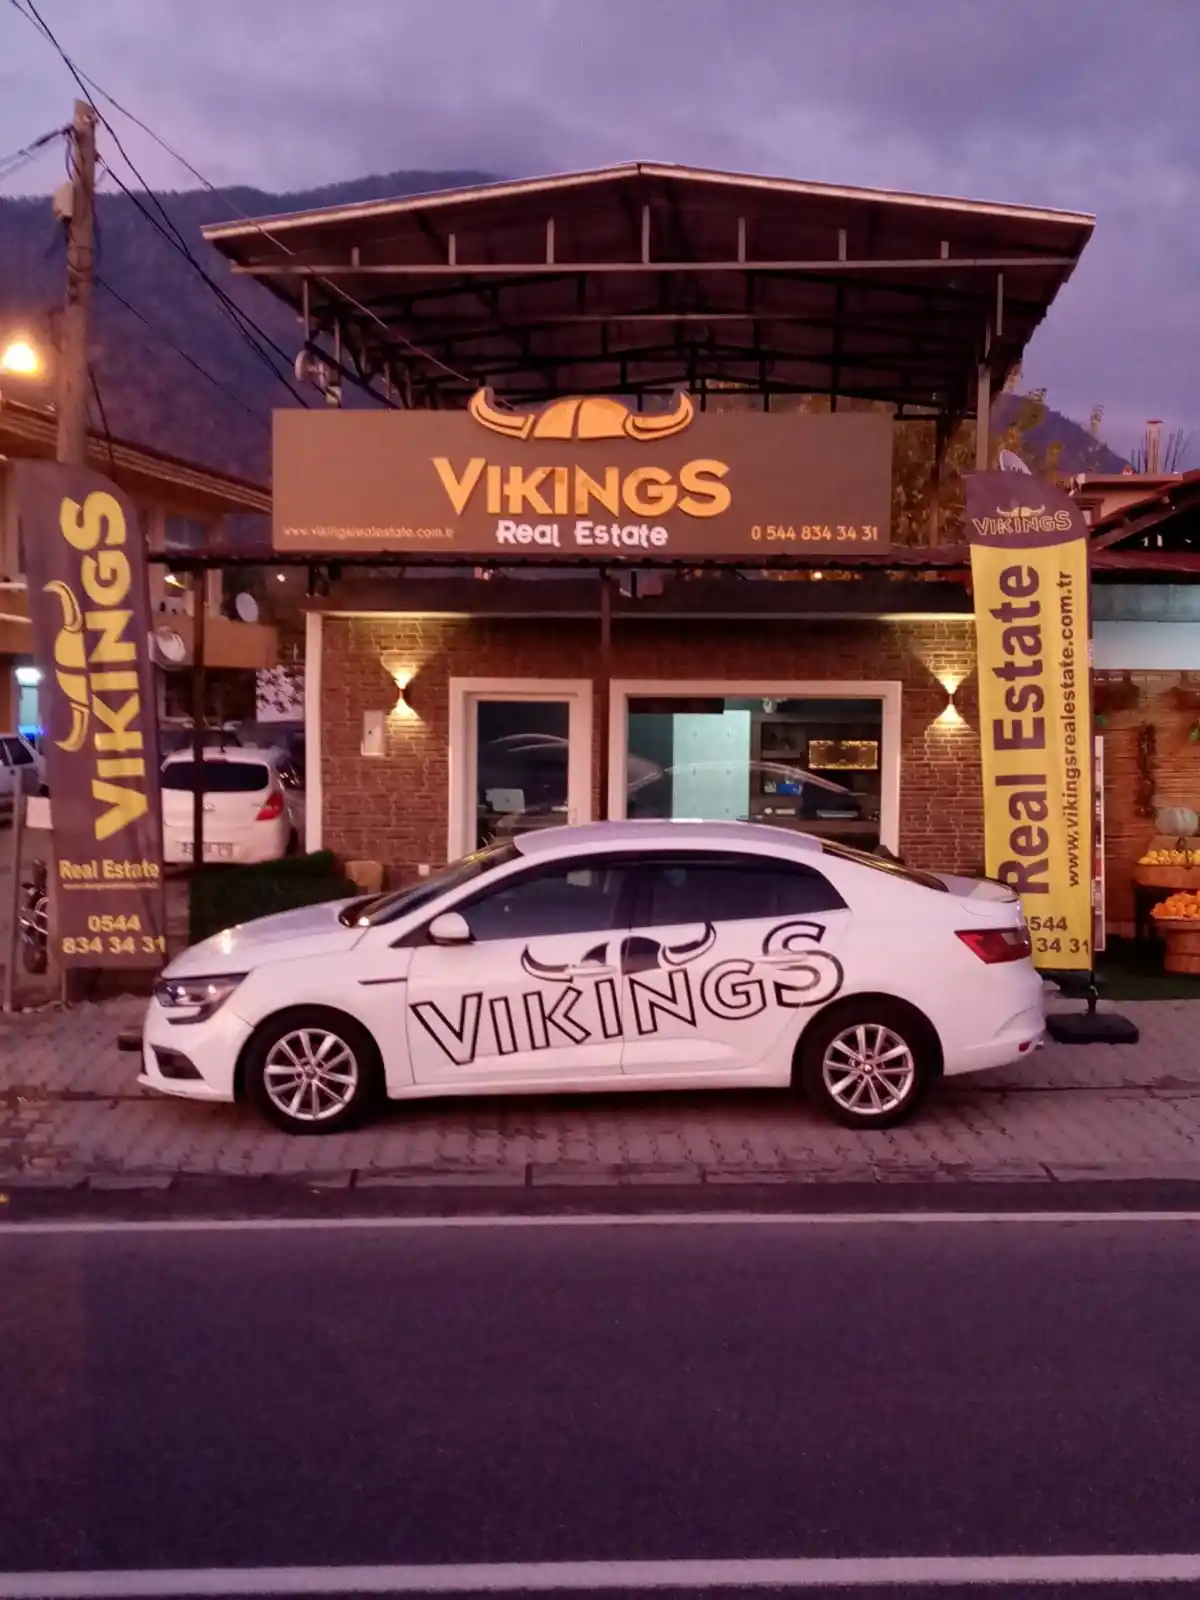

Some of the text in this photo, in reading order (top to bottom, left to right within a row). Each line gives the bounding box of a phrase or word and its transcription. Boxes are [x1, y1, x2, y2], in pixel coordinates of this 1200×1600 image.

[432, 457, 732, 517] VIKINGS
[496, 520, 669, 549] Real Estate
[751, 525, 878, 541] 0 544 834 34 31
[972, 510, 1072, 535] VIKINGS
[60, 490, 149, 841] VIKINGS
[990, 564, 1049, 894] Real Estate
[1056, 570, 1081, 887] www.vikingsrealestate.com.tr
[59, 859, 160, 879] Real Estate
[88, 915, 141, 932] 0544
[62, 935, 165, 954] 834 34 31
[1036, 937, 1062, 953] 34
[410, 921, 844, 1066] VIKINGS
